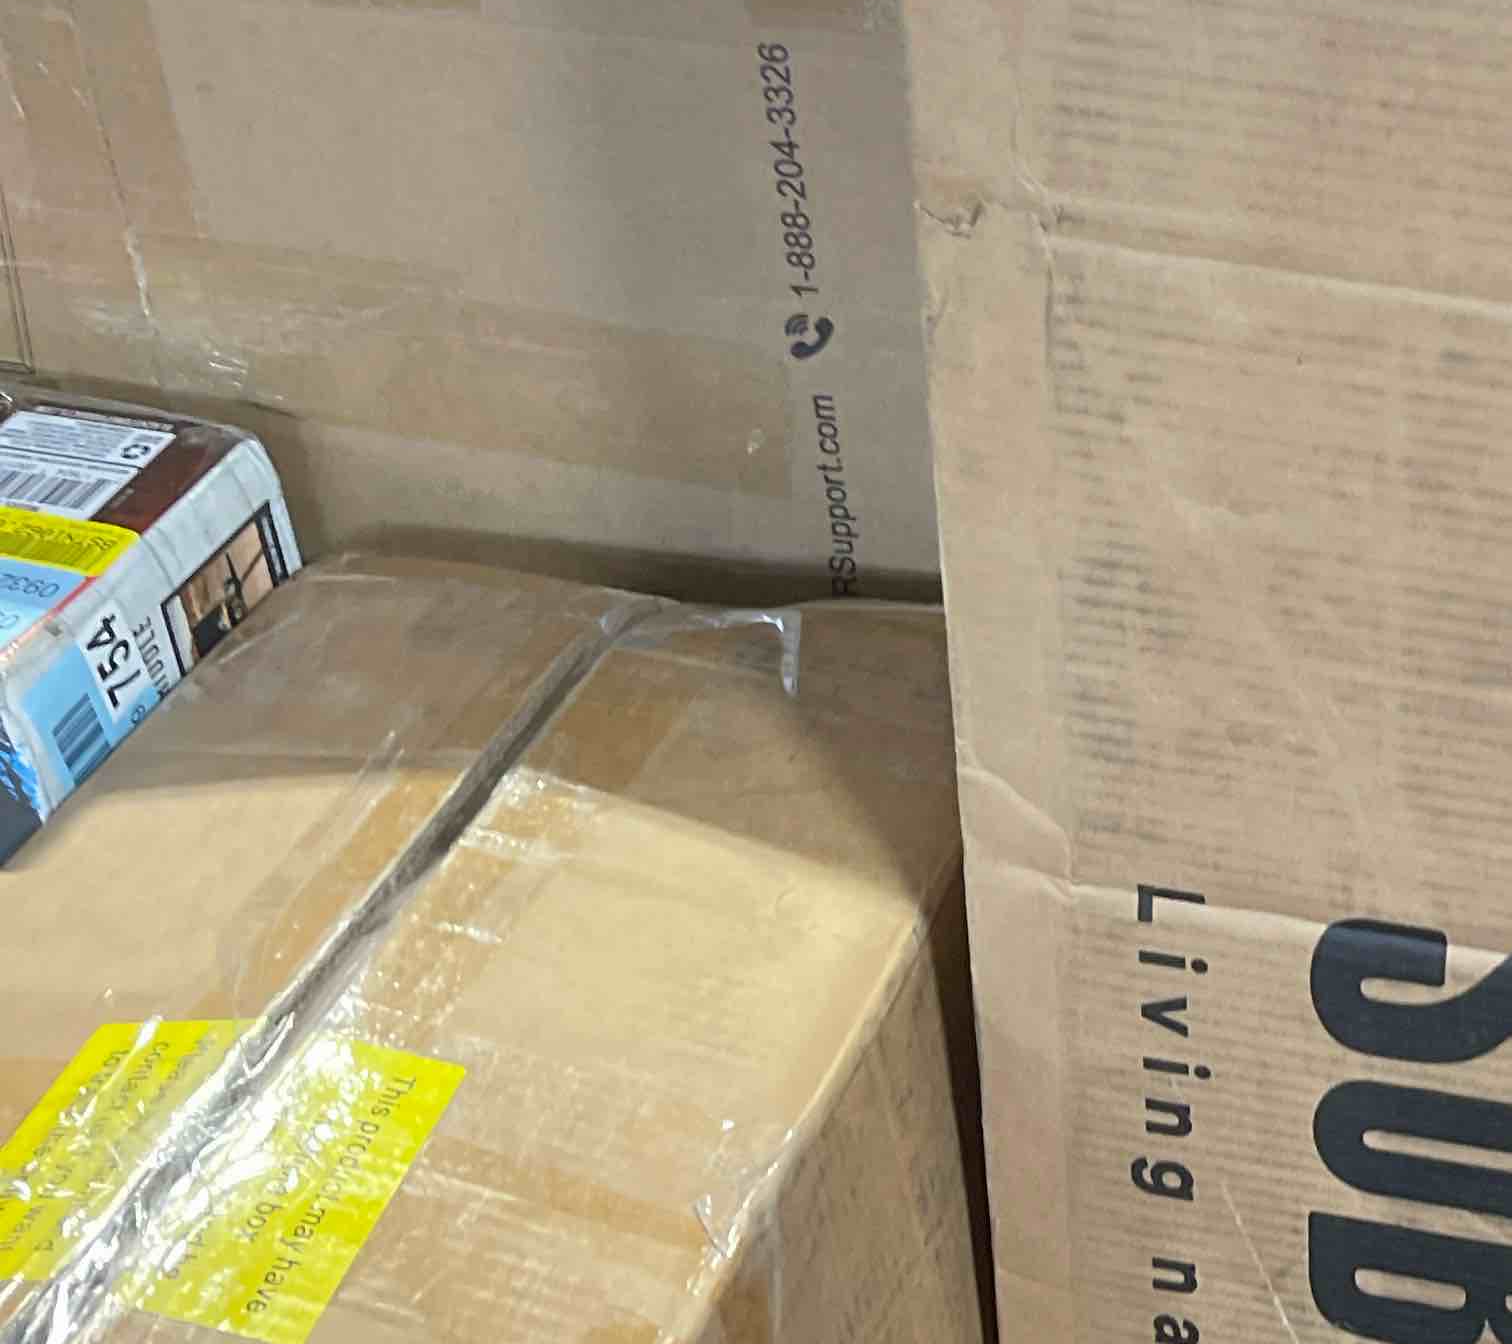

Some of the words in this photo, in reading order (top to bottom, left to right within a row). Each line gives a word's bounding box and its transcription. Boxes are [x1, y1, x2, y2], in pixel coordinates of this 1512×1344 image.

[757, 42, 819, 298] 1-888-204-3326
[87, 613, 141, 709] 754
[1131, 884, 1212, 1201] Living
[371, 1074, 417, 1119] This
[279, 1203, 327, 1254] may
[246, 1255, 302, 1314] have
